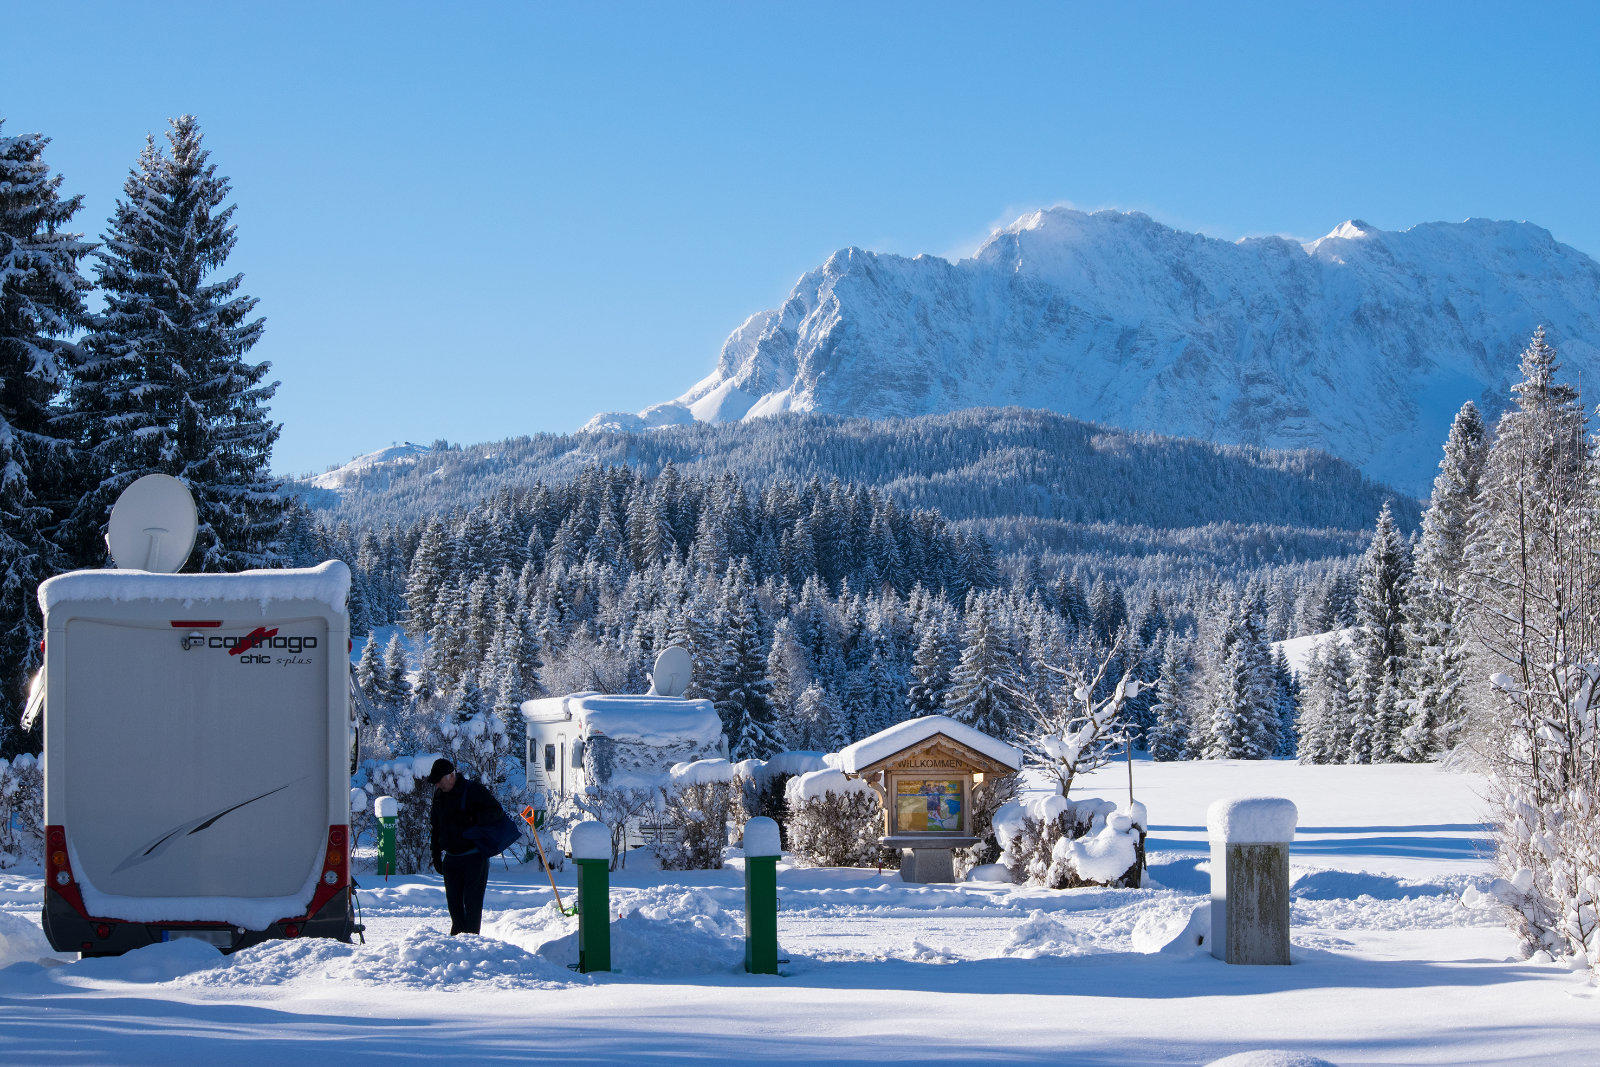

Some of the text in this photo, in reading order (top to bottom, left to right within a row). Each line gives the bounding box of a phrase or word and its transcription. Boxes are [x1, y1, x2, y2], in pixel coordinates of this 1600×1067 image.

[208, 633, 318, 654] carthago
[240, 654, 313, 668] chic s-plus
[898, 759, 963, 768] WILLKOMMEN
